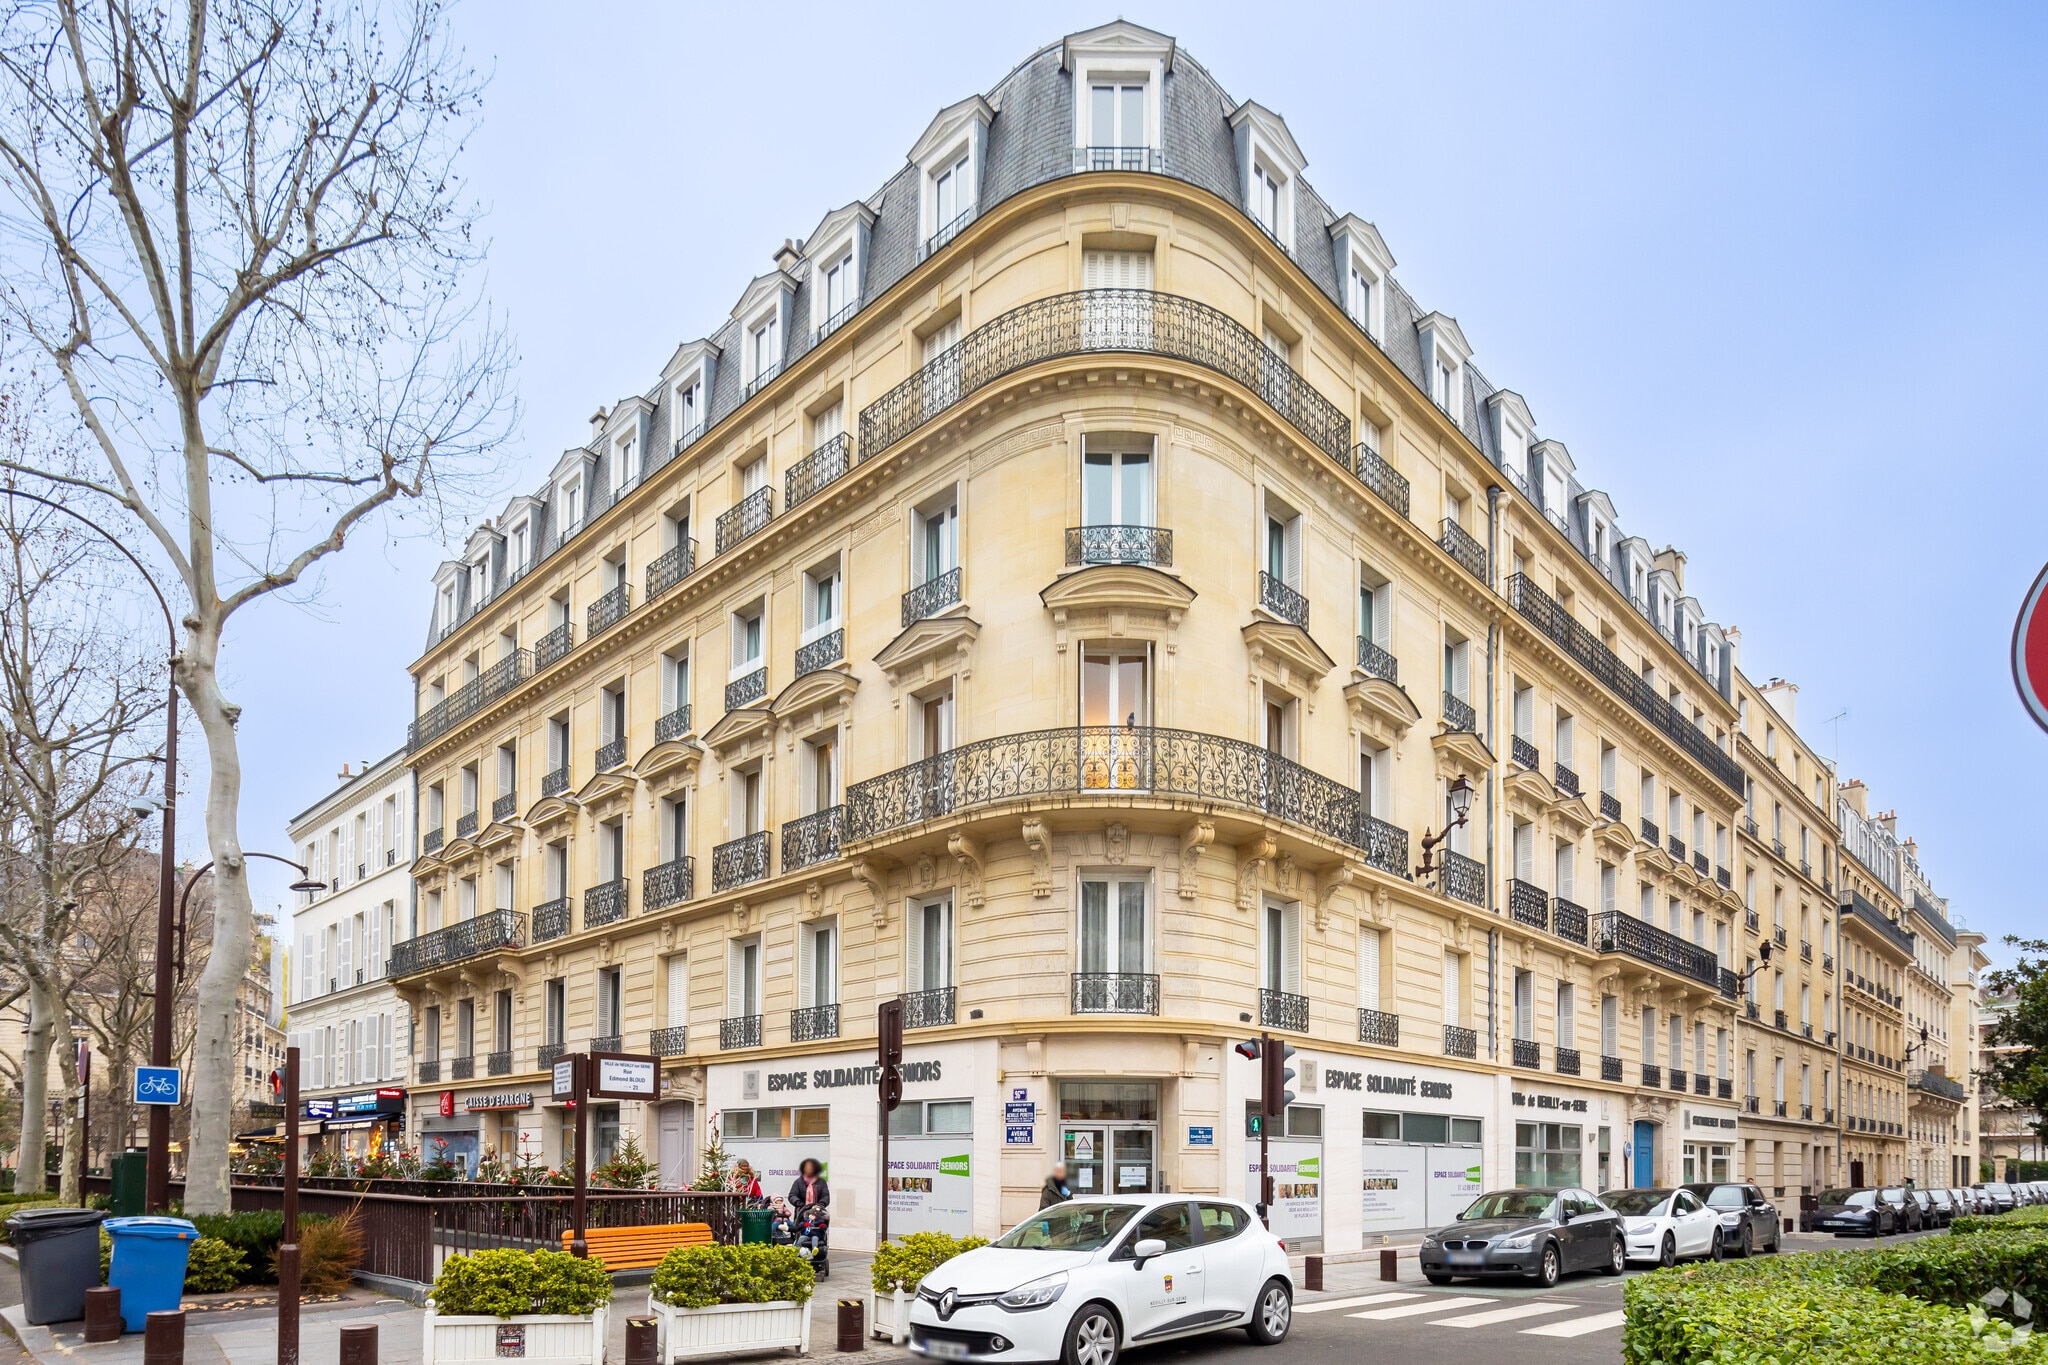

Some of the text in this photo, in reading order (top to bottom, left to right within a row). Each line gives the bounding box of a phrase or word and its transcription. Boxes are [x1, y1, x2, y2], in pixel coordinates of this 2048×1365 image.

[609, 1075, 629, 1083] Edmond
[767, 1060, 942, 1092] ESPACE SOLIDARITÉ ENIORS
[1325, 1069, 1453, 1100] ESPACE SOLIDARITÉ SENIORS
[464, 1096, 487, 1108] CAISSE
[905, 1159, 940, 1170] SOLIDARITÉ
[940, 1161, 968, 1171] SENIORS
[1269, 1163, 1297, 1173] SOLIDARITÉ
